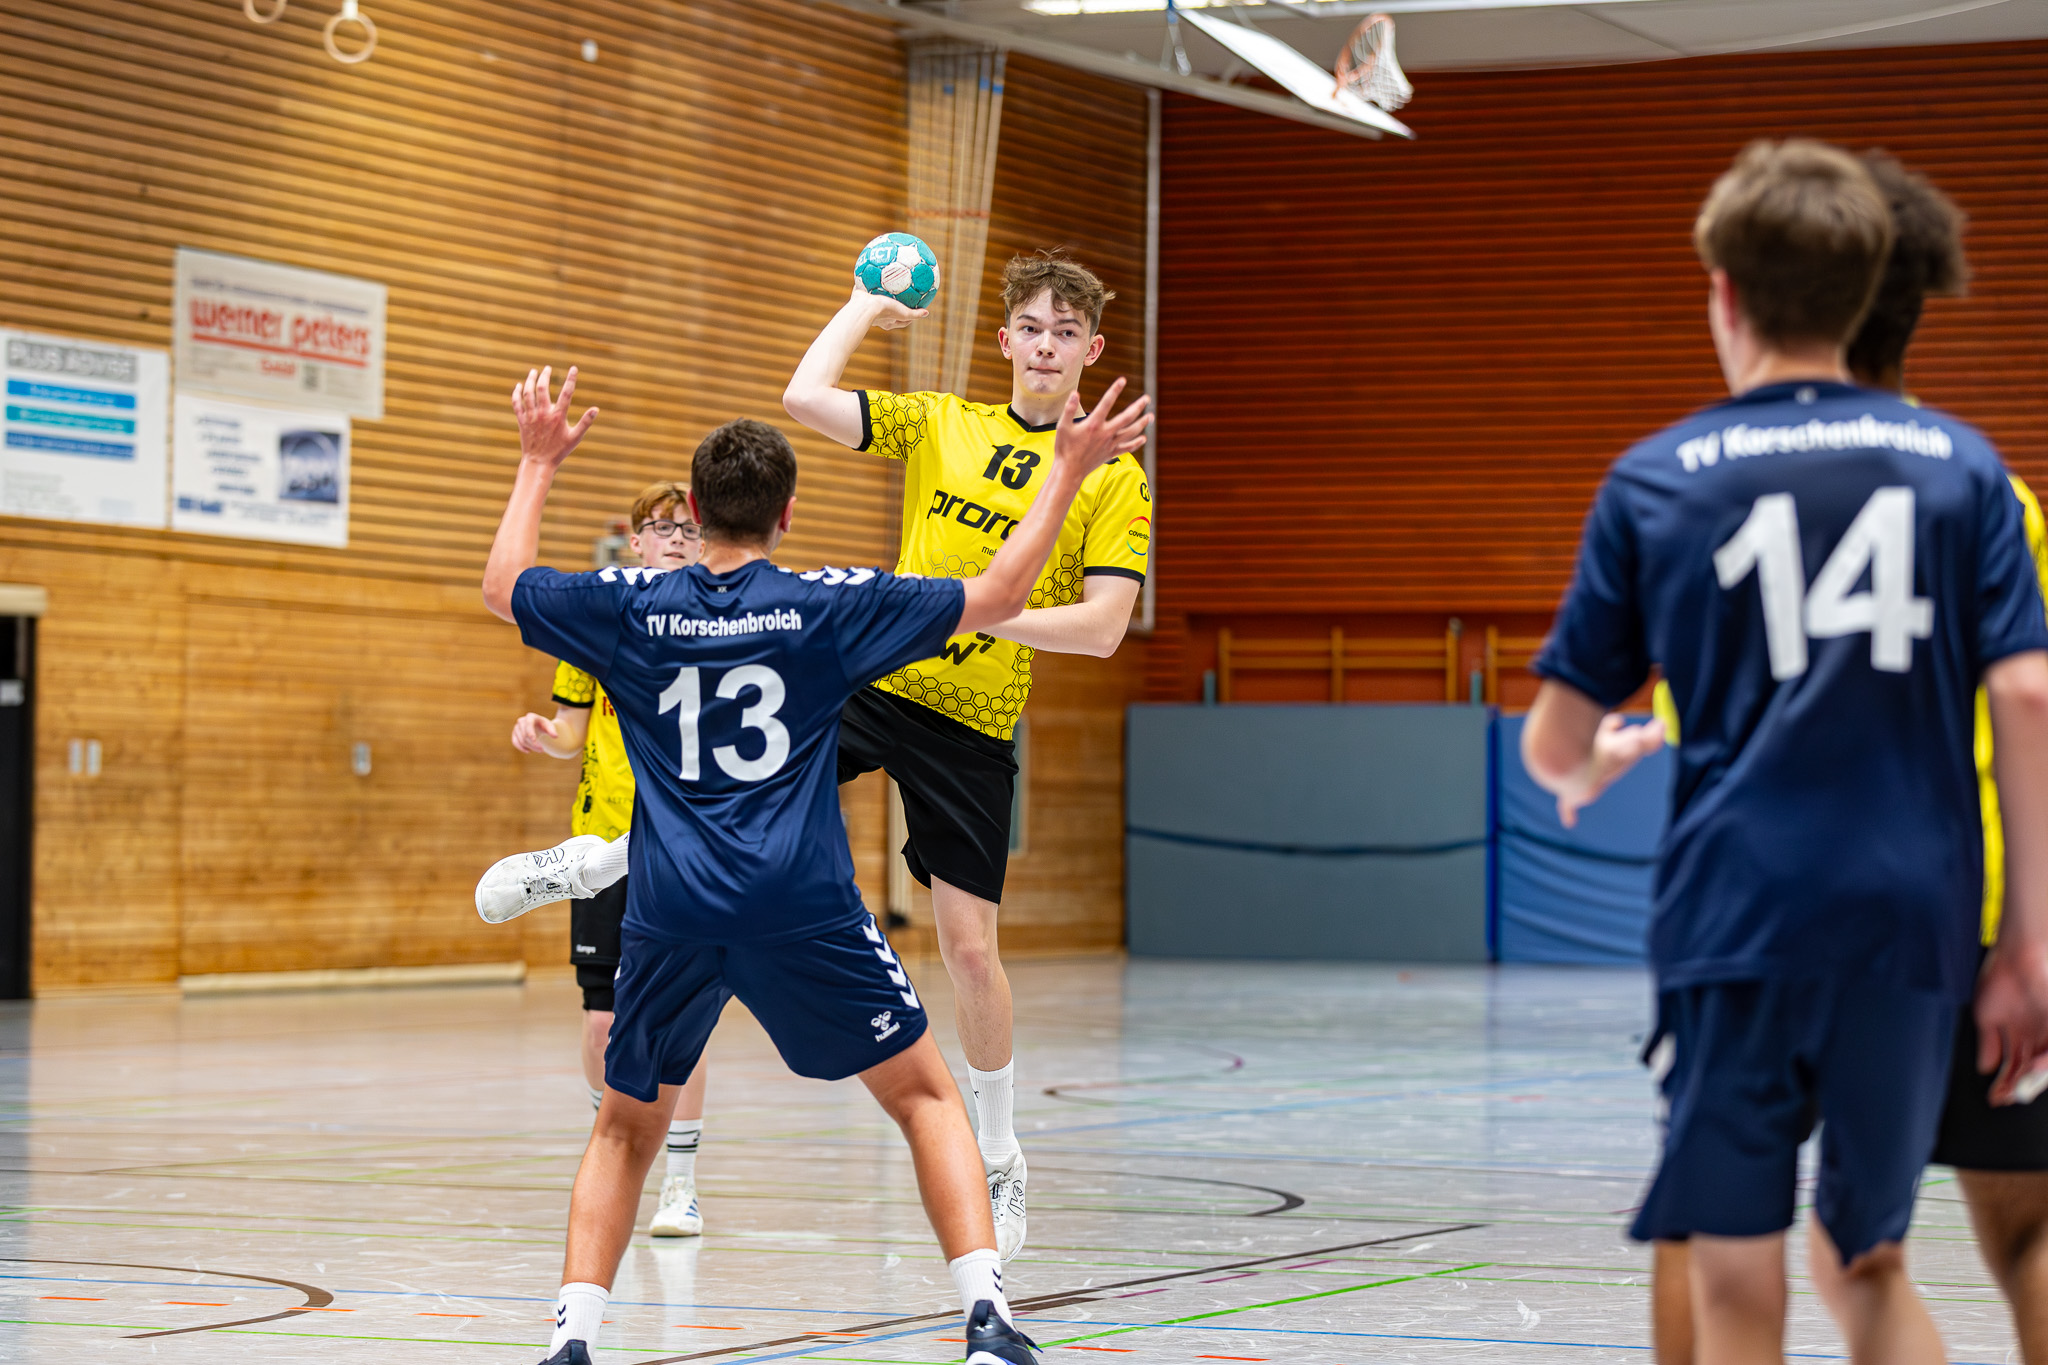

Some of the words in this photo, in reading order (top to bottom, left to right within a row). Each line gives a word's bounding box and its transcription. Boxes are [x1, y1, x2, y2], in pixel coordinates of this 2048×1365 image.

[982, 444, 1041, 490] 13
[1676, 430, 1721, 473] TV
[1722, 413, 1953, 460] Korschenbroich
[1712, 485, 1936, 682] 14
[646, 614, 667, 637] TV
[669, 608, 802, 637] Korschenbroich
[658, 664, 791, 782] 13
